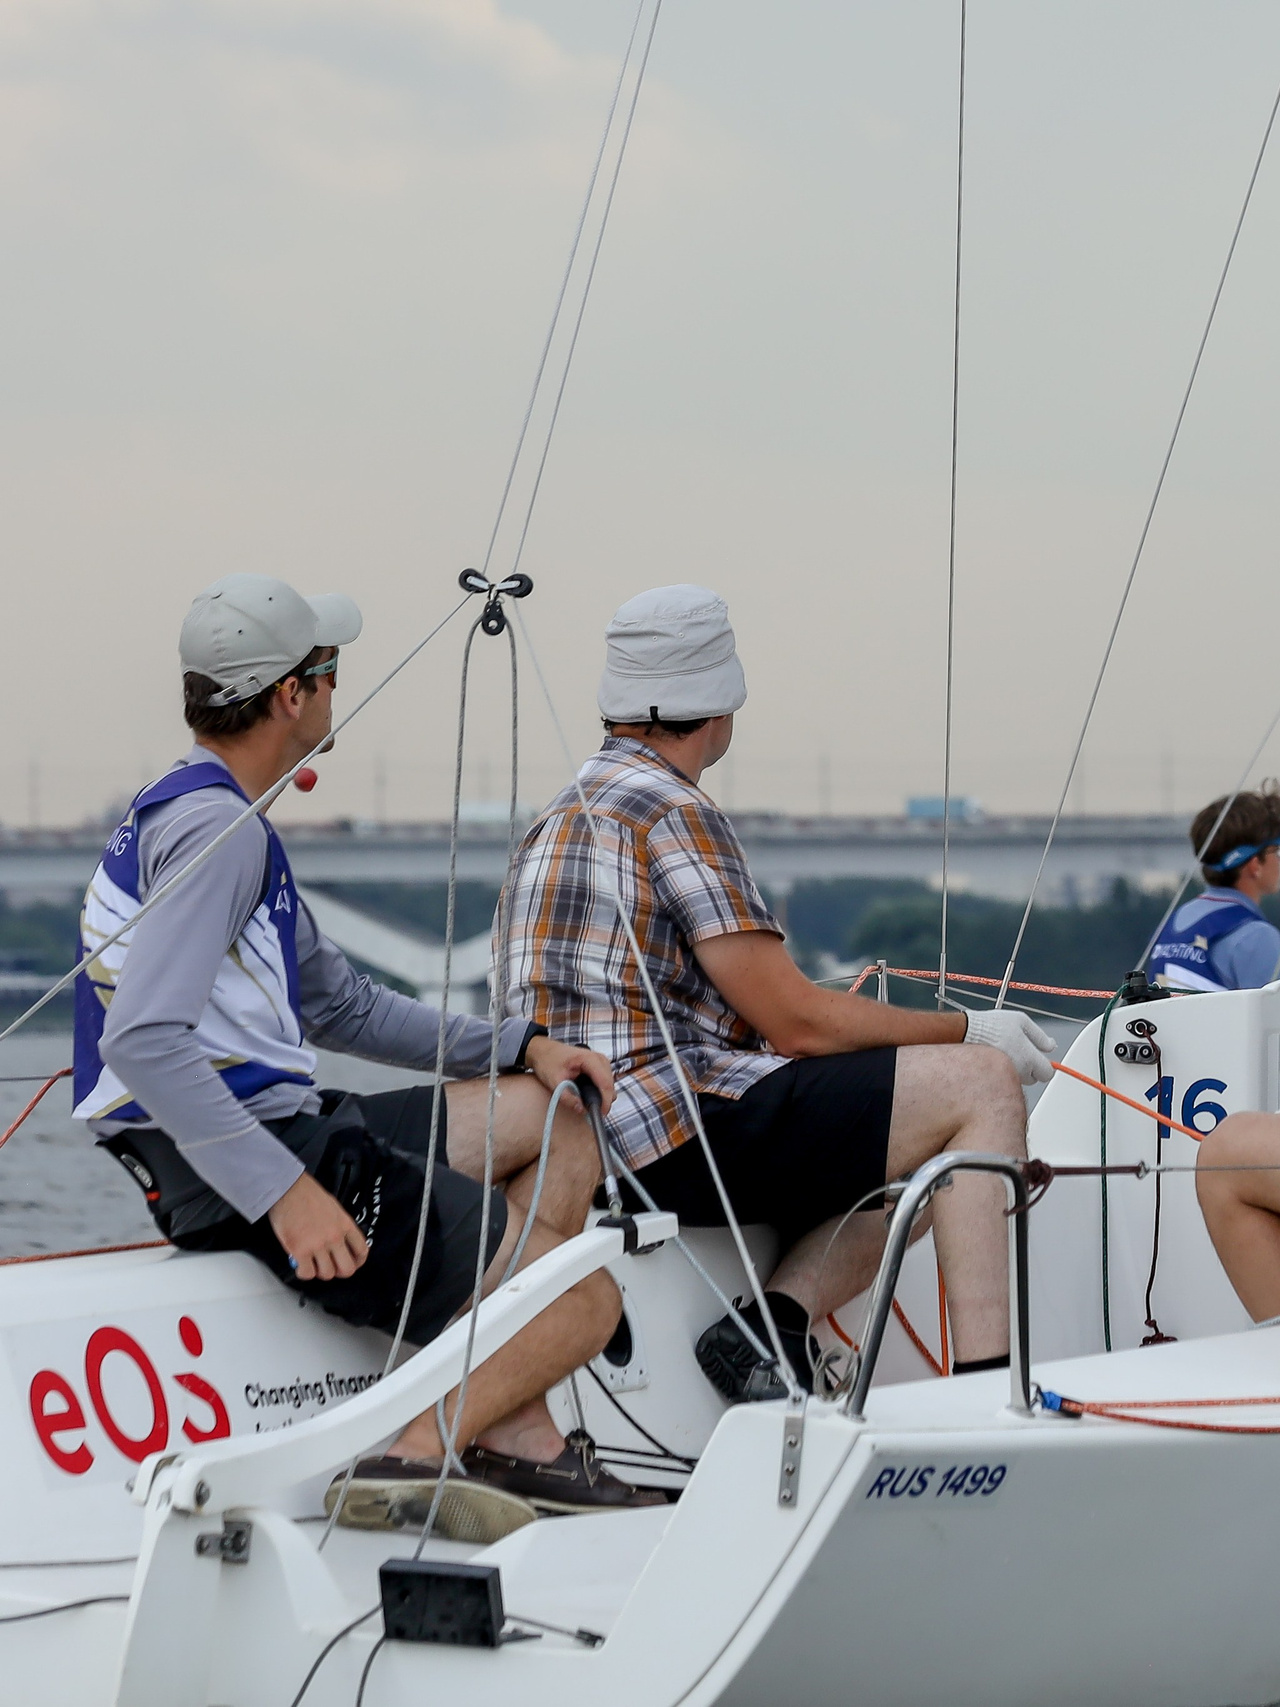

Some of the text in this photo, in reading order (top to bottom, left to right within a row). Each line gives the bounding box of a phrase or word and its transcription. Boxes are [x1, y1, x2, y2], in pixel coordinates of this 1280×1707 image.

[1144, 1075, 1228, 1139] 16
[244, 1376, 326, 1409] Changing
[866, 1463, 1007, 1499] RUS 1499
